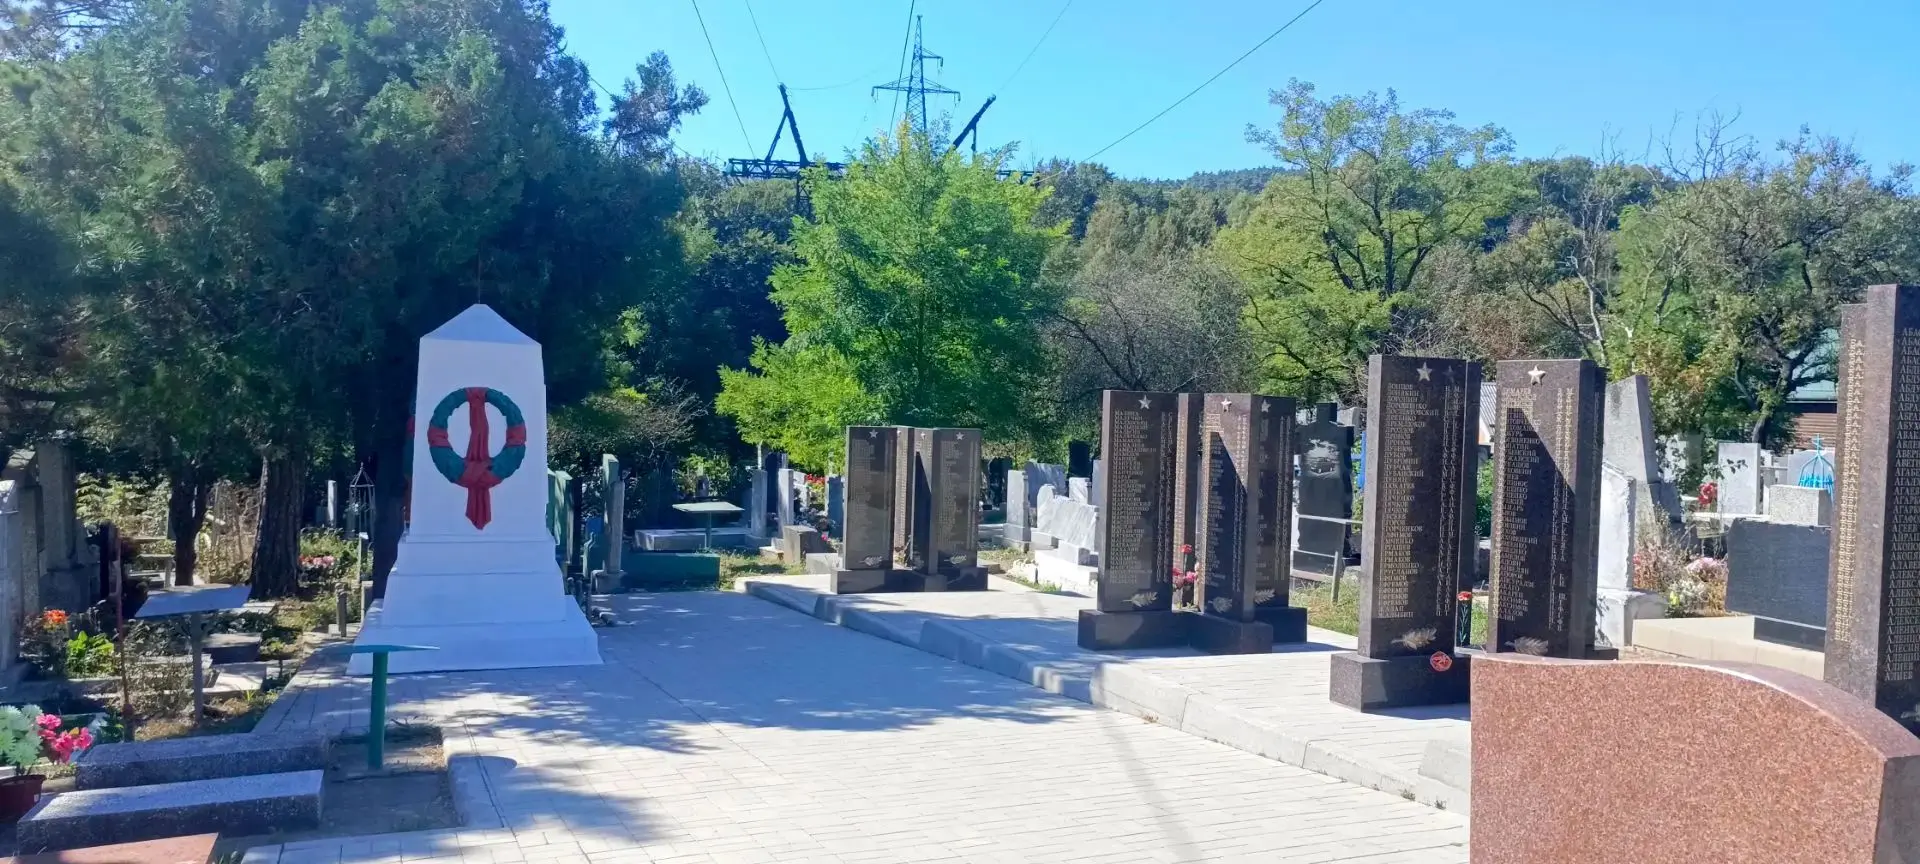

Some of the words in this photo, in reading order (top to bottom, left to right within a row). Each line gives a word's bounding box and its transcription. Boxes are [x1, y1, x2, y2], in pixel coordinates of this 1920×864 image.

[1902, 328, 1920, 337] АБА
[1898, 402, 1920, 411] АБРА
[1897, 411, 1920, 421] АБРА
[1893, 496, 1920, 505] АГАРК
[1892, 505, 1920, 514] АГАРК
[1890, 542, 1920, 551] АКОПО
[1890, 551, 1920, 560] АКОПЯ
[1889, 560, 1920, 569] АЛАВЕ
[1889, 570, 1920, 579] АЛЕКС
